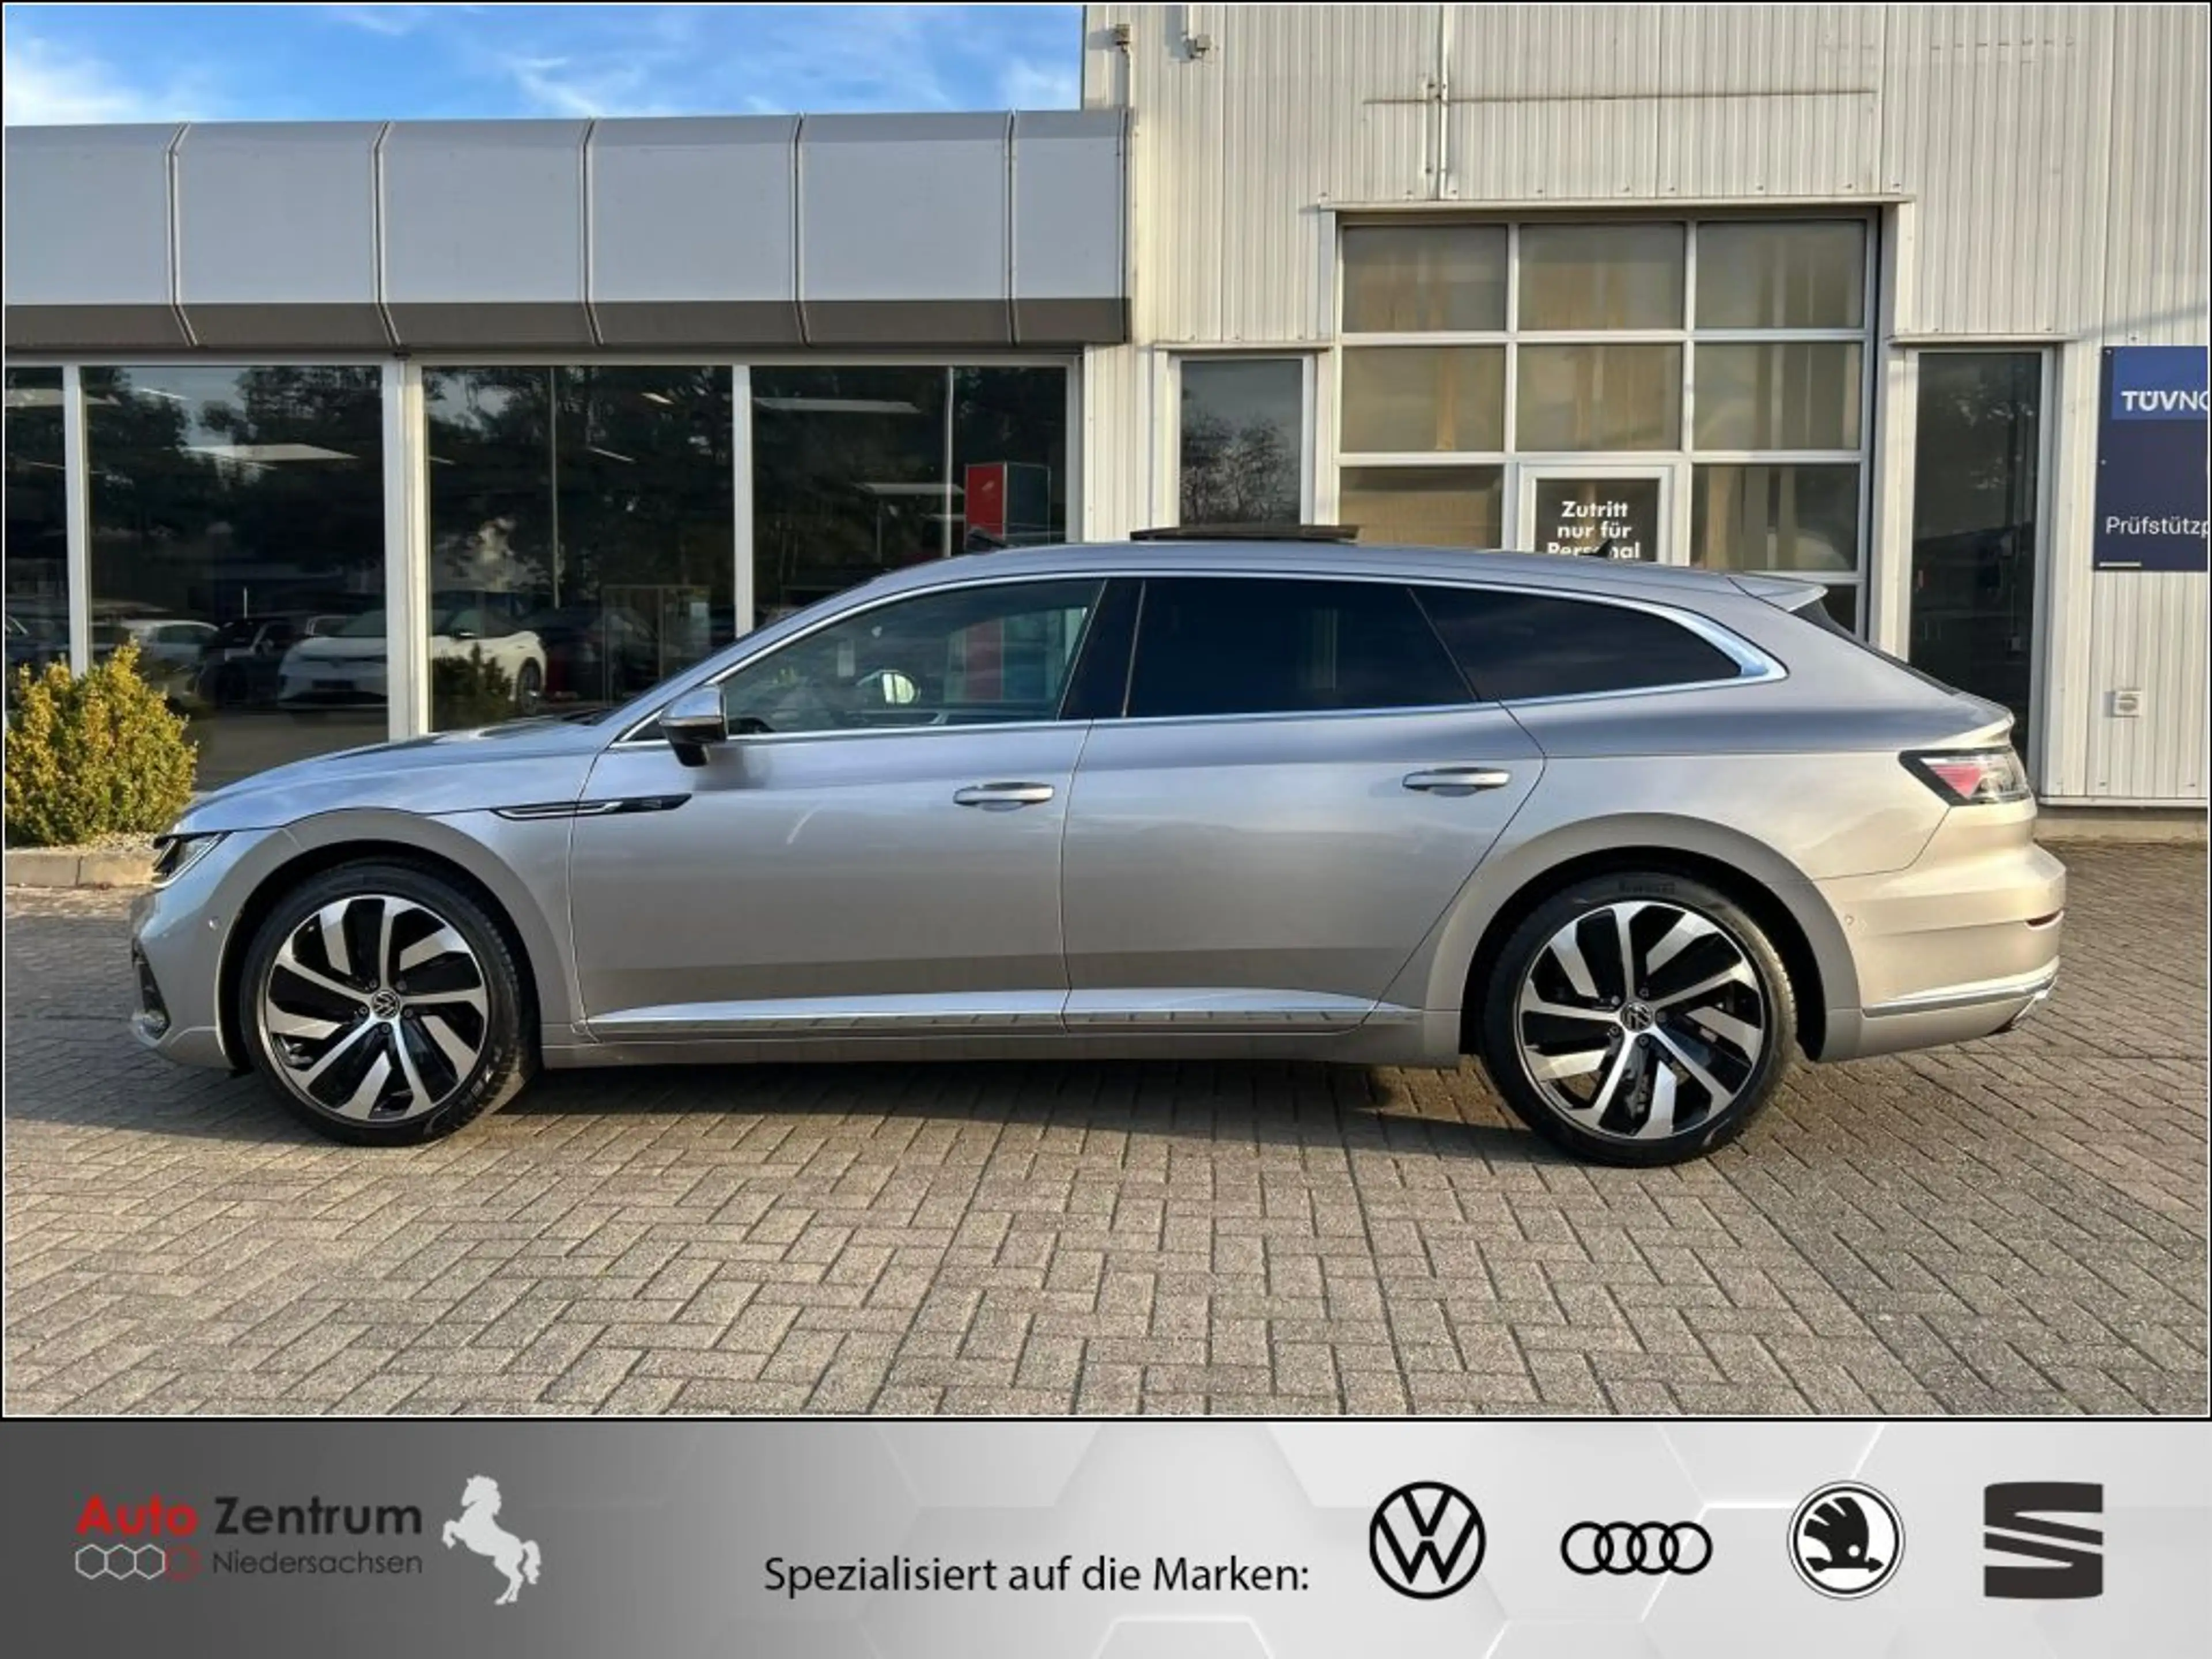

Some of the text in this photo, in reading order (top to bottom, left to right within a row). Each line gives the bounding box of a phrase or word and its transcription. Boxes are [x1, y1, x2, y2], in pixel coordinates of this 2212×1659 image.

[1561, 501, 1628, 518] Zutritt
[1557, 520, 1632, 539] nur für
[2105, 516, 2207, 539] Prüfstützp
[1547, 541, 1641, 559] Persnal
